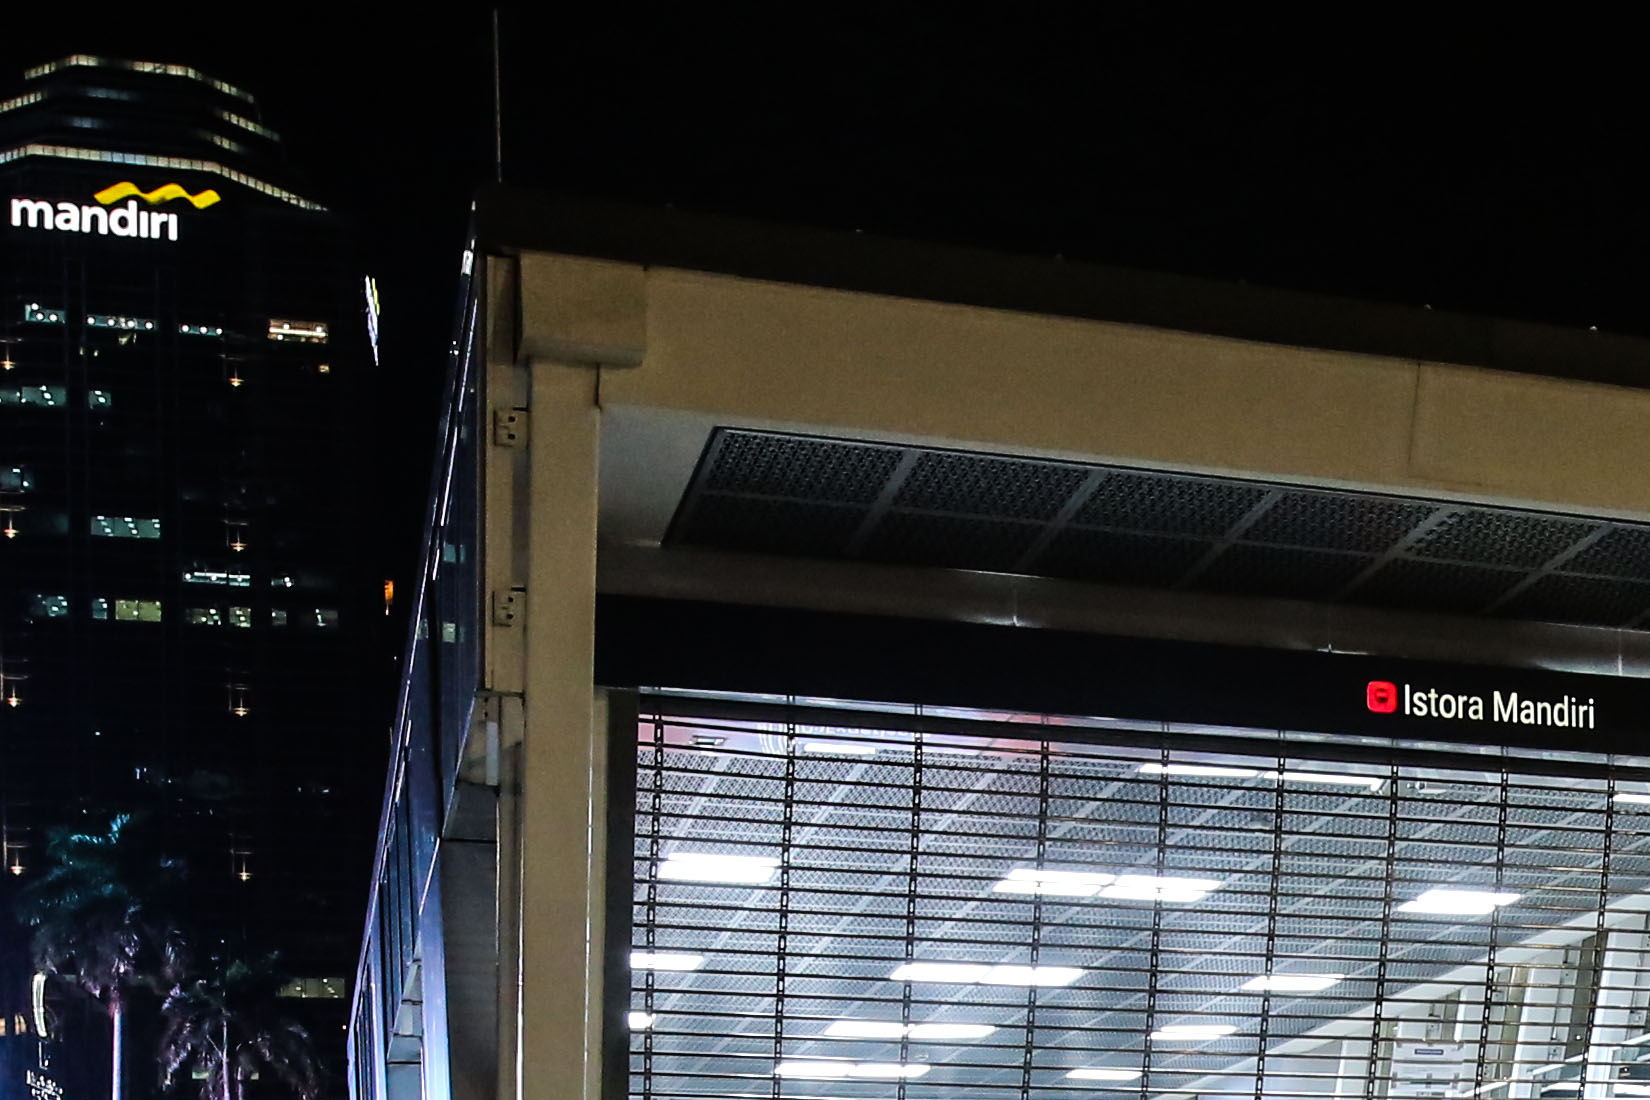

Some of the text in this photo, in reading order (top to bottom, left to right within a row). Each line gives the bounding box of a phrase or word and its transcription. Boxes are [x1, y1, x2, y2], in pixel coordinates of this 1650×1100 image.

[11, 197, 178, 241] mandiri
[1404, 683, 1595, 729] Istora Mandiri
